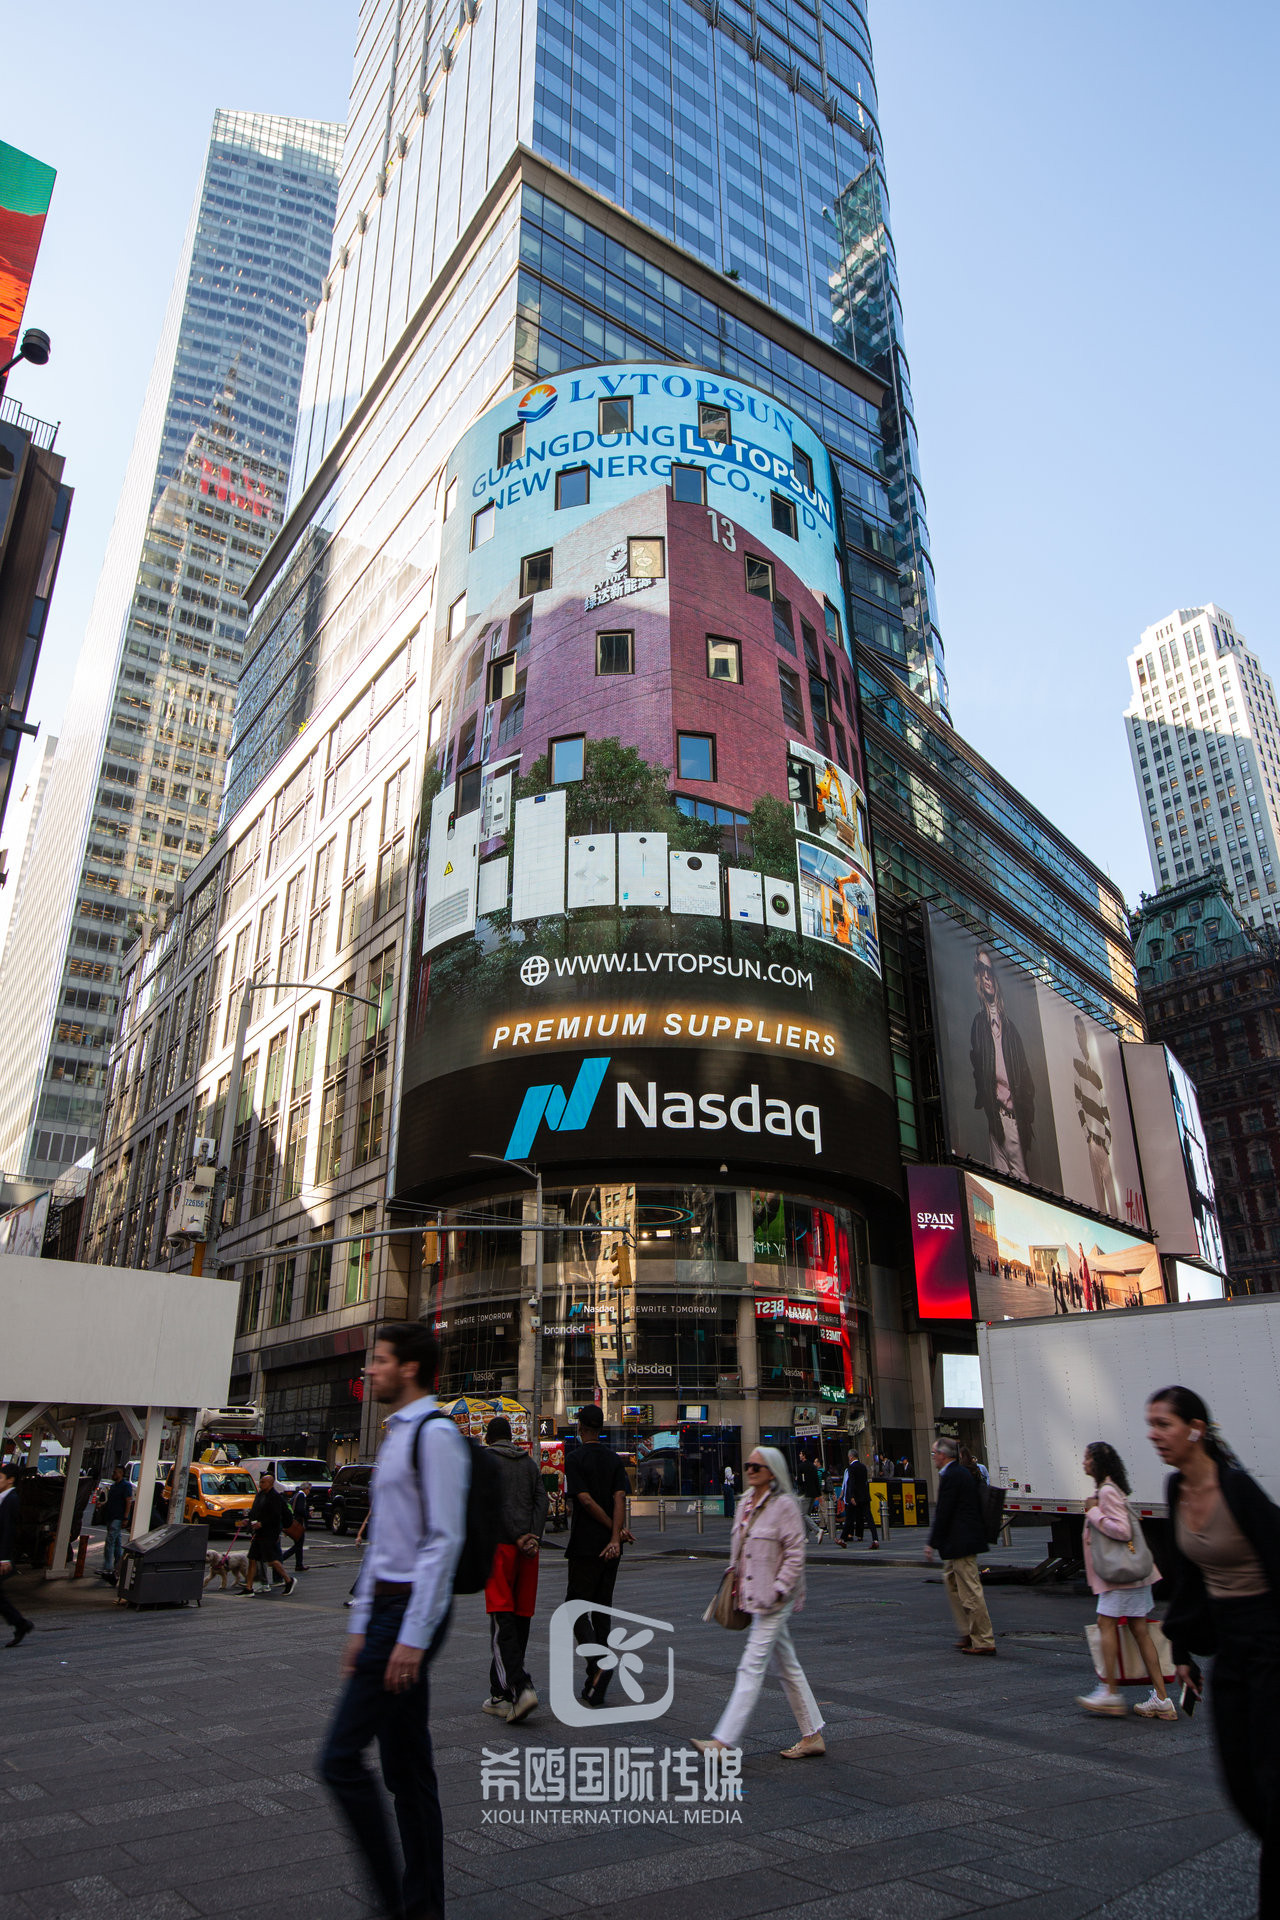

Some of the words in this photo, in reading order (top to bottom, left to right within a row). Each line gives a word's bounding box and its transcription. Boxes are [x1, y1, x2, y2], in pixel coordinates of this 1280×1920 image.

[570, 374, 793, 441] LVTOPSUN
[472, 425, 674, 497] GUANGDONG
[686, 429, 831, 523] LVTOPSUN
[489, 467, 551, 509] NEW
[562, 455, 696, 478] NERG
[707, 510, 736, 552] 13
[554, 953, 813, 990] WWW.LVTOPSUN.COM
[492, 1013, 647, 1049] PREMIUM
[663, 1013, 836, 1056] SUPPLIERS
[617, 1081, 822, 1154] Nasdaq
[917, 1213, 954, 1224] SPAIN
[477, 1312, 512, 1322] TOMORROW
[584, 1305, 615, 1314] Nasdaq
[630, 1305, 667, 1313] REWRITE
[671, 1306, 717, 1314] TOMORROW
[628, 1363, 672, 1376] Nasdaq
